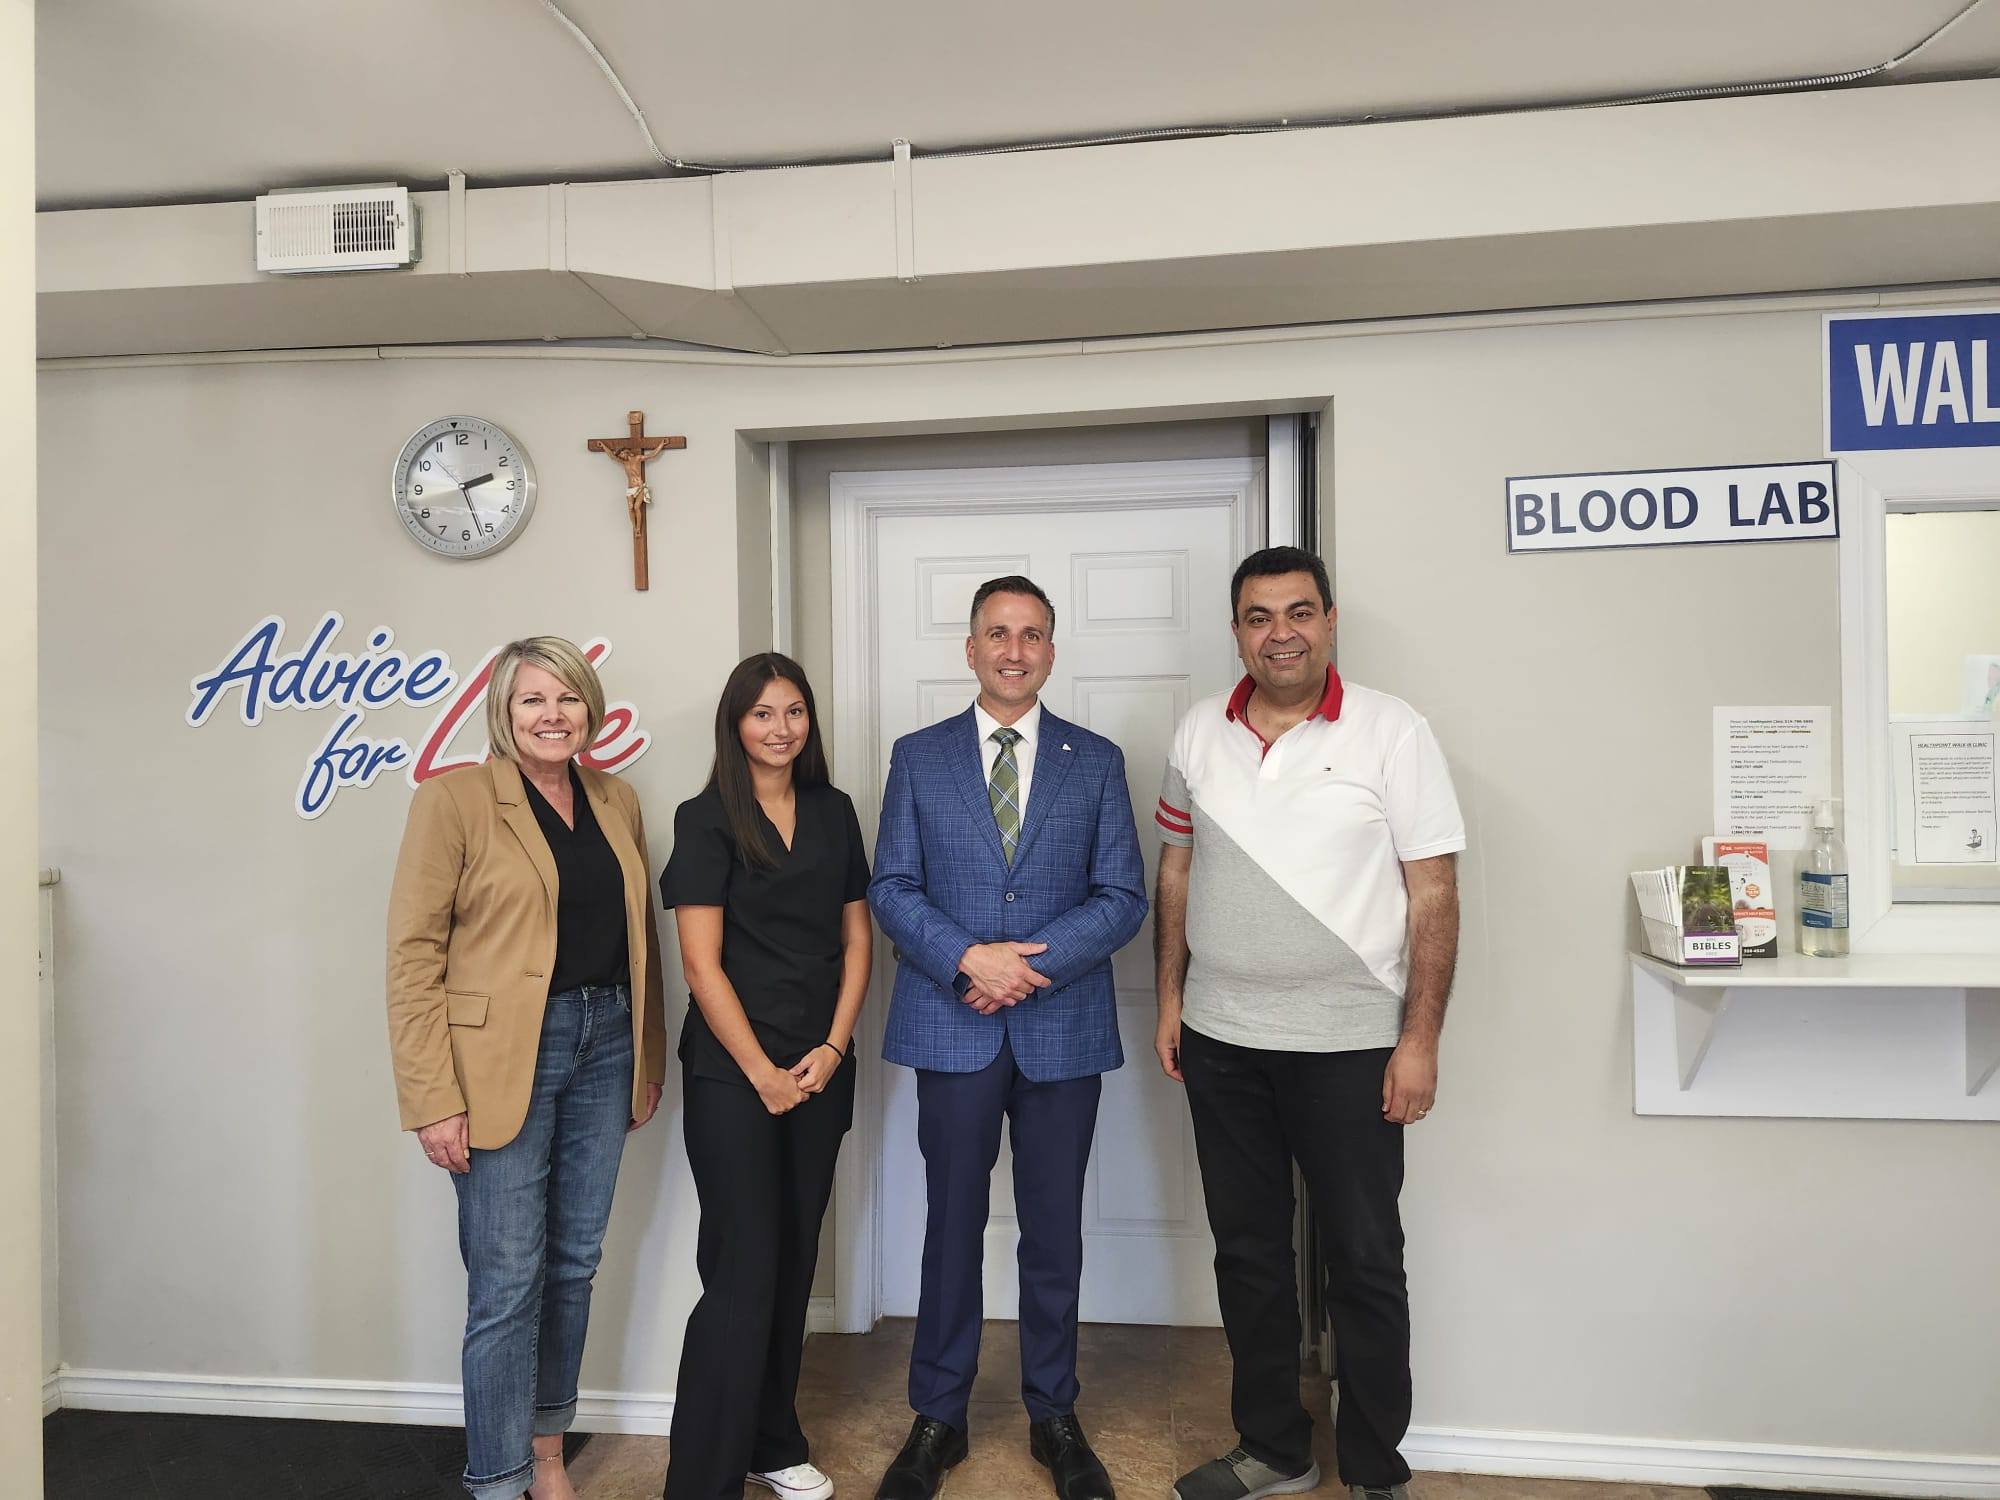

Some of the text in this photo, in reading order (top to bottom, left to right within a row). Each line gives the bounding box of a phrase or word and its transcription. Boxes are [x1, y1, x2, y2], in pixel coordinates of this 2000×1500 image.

[455, 433, 469, 446] 12
[436, 441, 443, 453] 11
[419, 460, 431, 472] 10
[498, 456, 508, 467] 2
[414, 484, 423, 495] 9
[505, 480, 515, 491] 3
[420, 508, 430, 519] 8
[501, 504, 510, 514] 4
[1515, 480, 1830, 536] BLOOD LAB
[438, 525, 447, 535] 7
[484, 523, 494, 533] 5
[461, 530, 471, 541] 6
[192, 617, 450, 720] Advice
[302, 712, 406, 813] for
[1692, 942, 1731, 951] BIBLES
